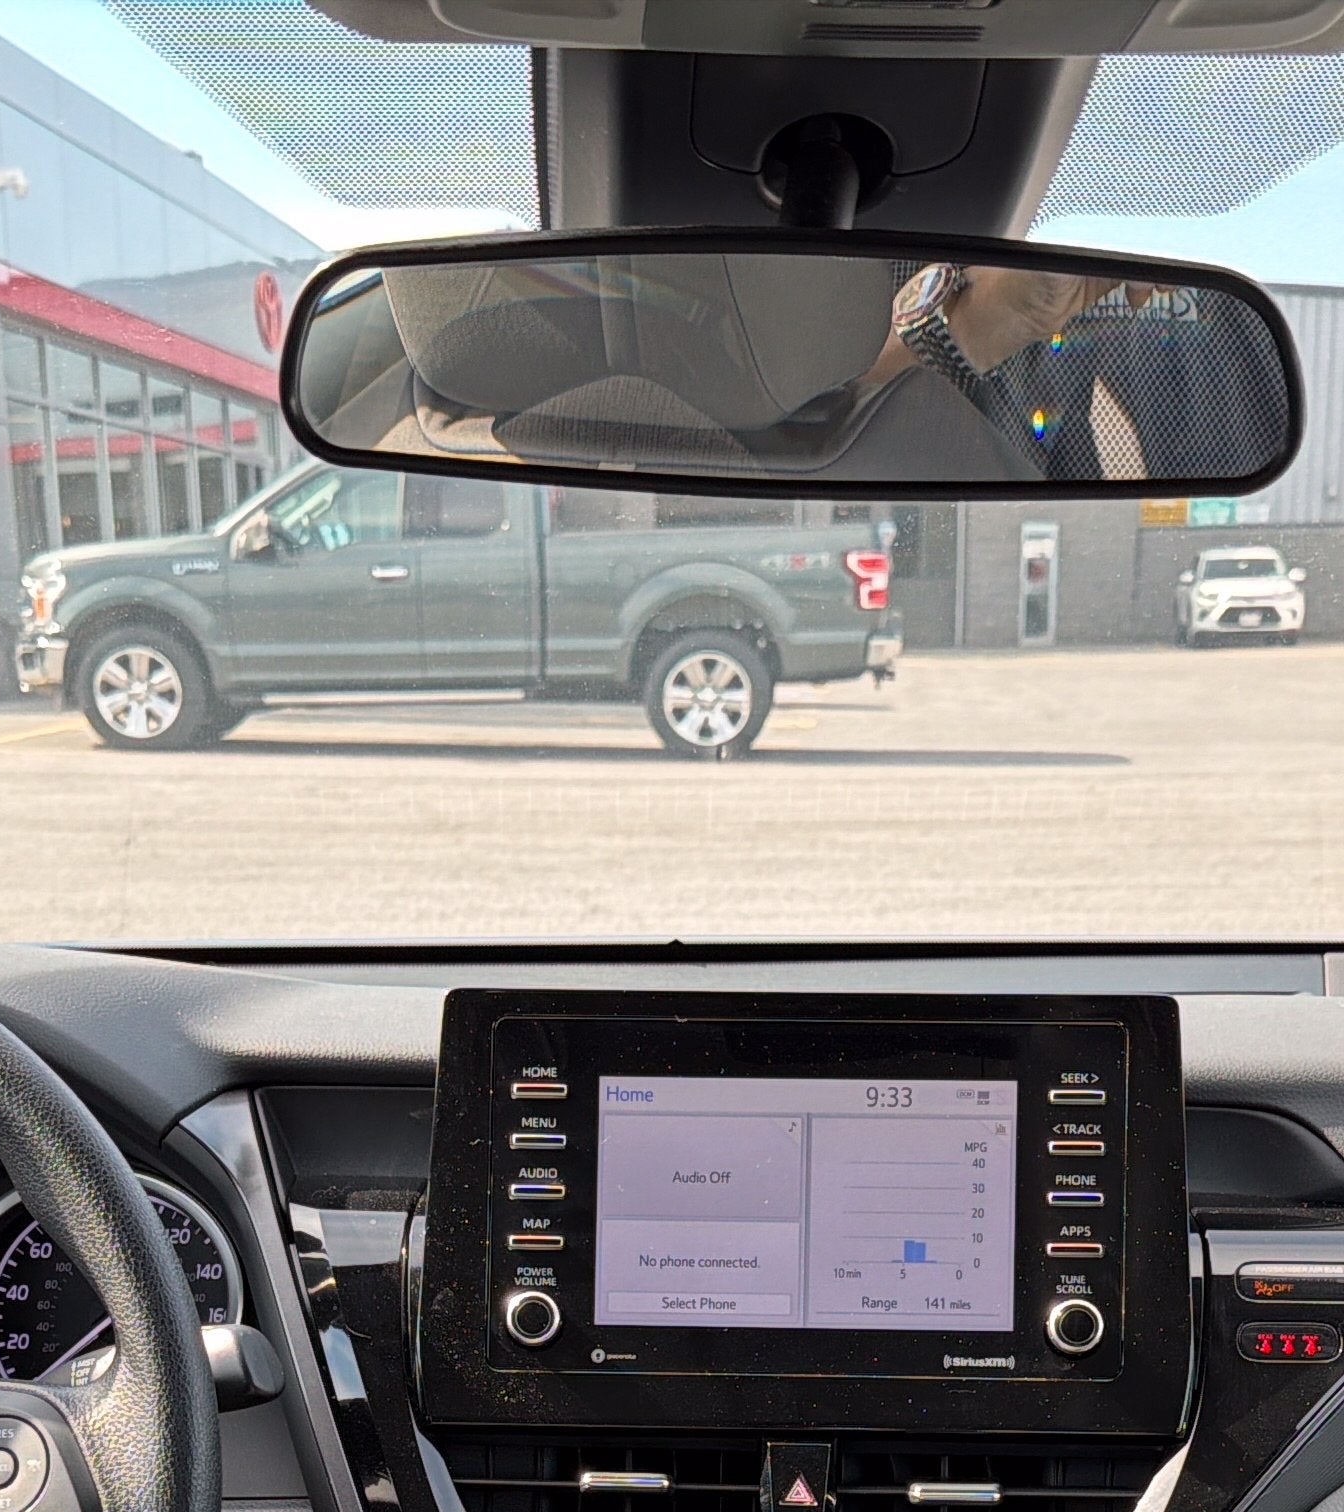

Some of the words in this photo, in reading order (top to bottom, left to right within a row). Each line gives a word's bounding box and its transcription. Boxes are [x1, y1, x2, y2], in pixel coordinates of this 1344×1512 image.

[522, 1067, 558, 1078] HOME
[606, 1086, 654, 1102] Home
[866, 1087, 913, 1108] 9:33
[521, 1117, 557, 1128] MENU
[1063, 1124, 1102, 1135] TRACK
[964, 1142, 988, 1153] MPG
[972, 1158, 986, 1169] 40
[518, 1168, 558, 1179] AUDIO
[672, 1172, 707, 1184] Audio
[709, 1171, 732, 1184] Off
[1056, 1175, 1097, 1186] PHONE
[972, 1183, 985, 1194] 30
[972, 1208, 985, 1219] 20
[522, 1218, 551, 1229] MAP
[1060, 1226, 1091, 1237] APPS
[972, 1233, 984, 1244] 10
[29, 1242, 53, 1258] 60
[639, 1255, 657, 1268] No
[659, 1255, 696, 1270] phone
[698, 1256, 761, 1269] connected.
[974, 1258, 981, 1269] 0
[196, 1263, 223, 1280] 140
[517, 1267, 553, 1277] POWER
[834, 1268, 846, 1279] 10
[847, 1268, 862, 1279] min
[900, 1269, 907, 1280] 5
[956, 1270, 963, 1280] 0
[44, 1280, 59, 1289] 80
[514, 1277, 557, 1287] VOLUME
[1061, 1275, 1086, 1284] TUNE
[6, 1284, 29, 1300] 40
[1056, 1284, 1092, 1294] SCROLL
[37, 1301, 50, 1310] 60
[662, 1297, 697, 1310] Select
[700, 1297, 737, 1310] Phone
[862, 1297, 898, 1311] Range
[925, 1298, 946, 1310] 141
[949, 1299, 971, 1310] miles
[36, 1322, 50, 1331] 40
[7, 1333, 30, 1349] 20
[42, 1343, 55, 1352] 20
